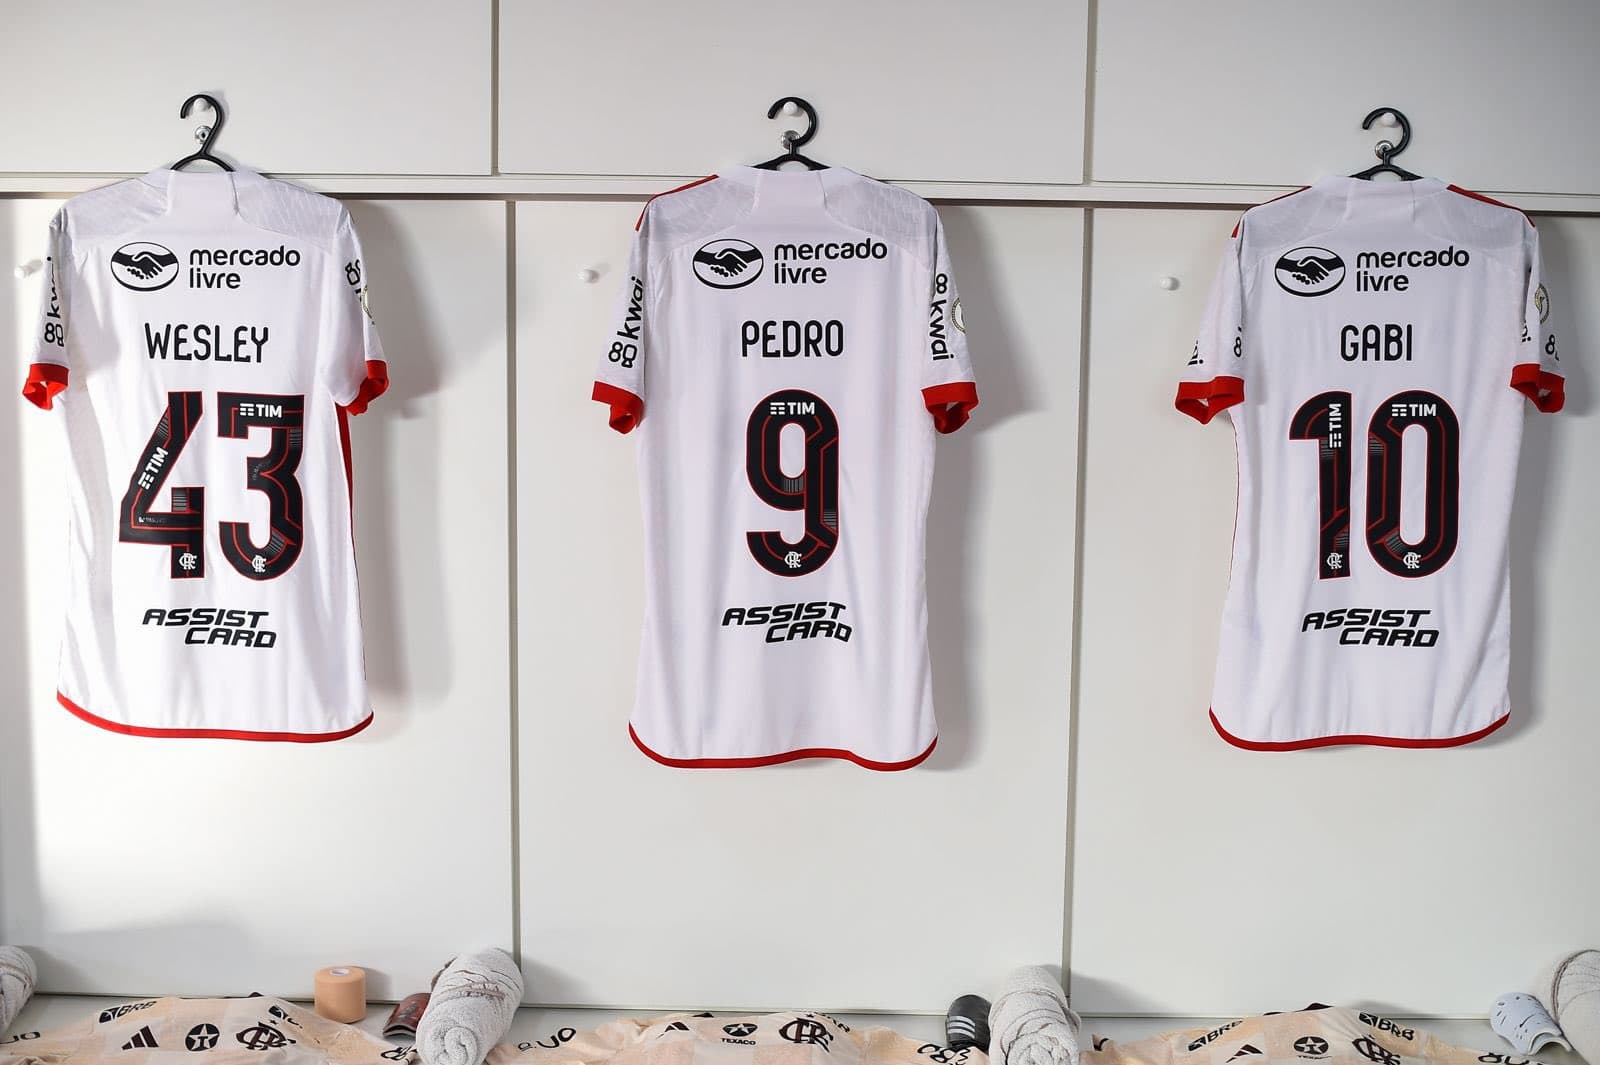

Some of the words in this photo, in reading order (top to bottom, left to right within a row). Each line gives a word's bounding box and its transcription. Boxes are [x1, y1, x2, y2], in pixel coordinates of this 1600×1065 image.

[190, 245, 301, 267] mercado
[774, 238, 887, 260] mercado
[1356, 246, 1470, 268] mercado
[189, 268, 241, 290] livre
[774, 263, 826, 284] livre
[1356, 270, 1409, 292] livre
[617, 276, 643, 340] kwai
[742, 320, 843, 357] PEDRO
[929, 299, 954, 361] kwai
[145, 323, 269, 363] WESLEY
[1341, 324, 1412, 361] GABI
[255, 404, 282, 418] TIM
[787, 402, 815, 415] TIM
[1329, 403, 1342, 432] TIM
[1409, 403, 1437, 417] TIM
[145, 447, 169, 475] TIM
[119, 391, 304, 580] 43
[746, 390, 839, 577] 9
[1289, 390, 1460, 579] 10
[142, 608, 269, 627] ASSIST
[722, 602, 846, 627] ASSIST
[1302, 608, 1430, 633] ASSIST
[185, 627, 276, 648] CARD
[765, 620, 852, 643] CARD
[1339, 627, 1440, 648] CARD
[1379, 1018, 1415, 1041] BRB
[720, 1037, 757, 1046] TEXACO
